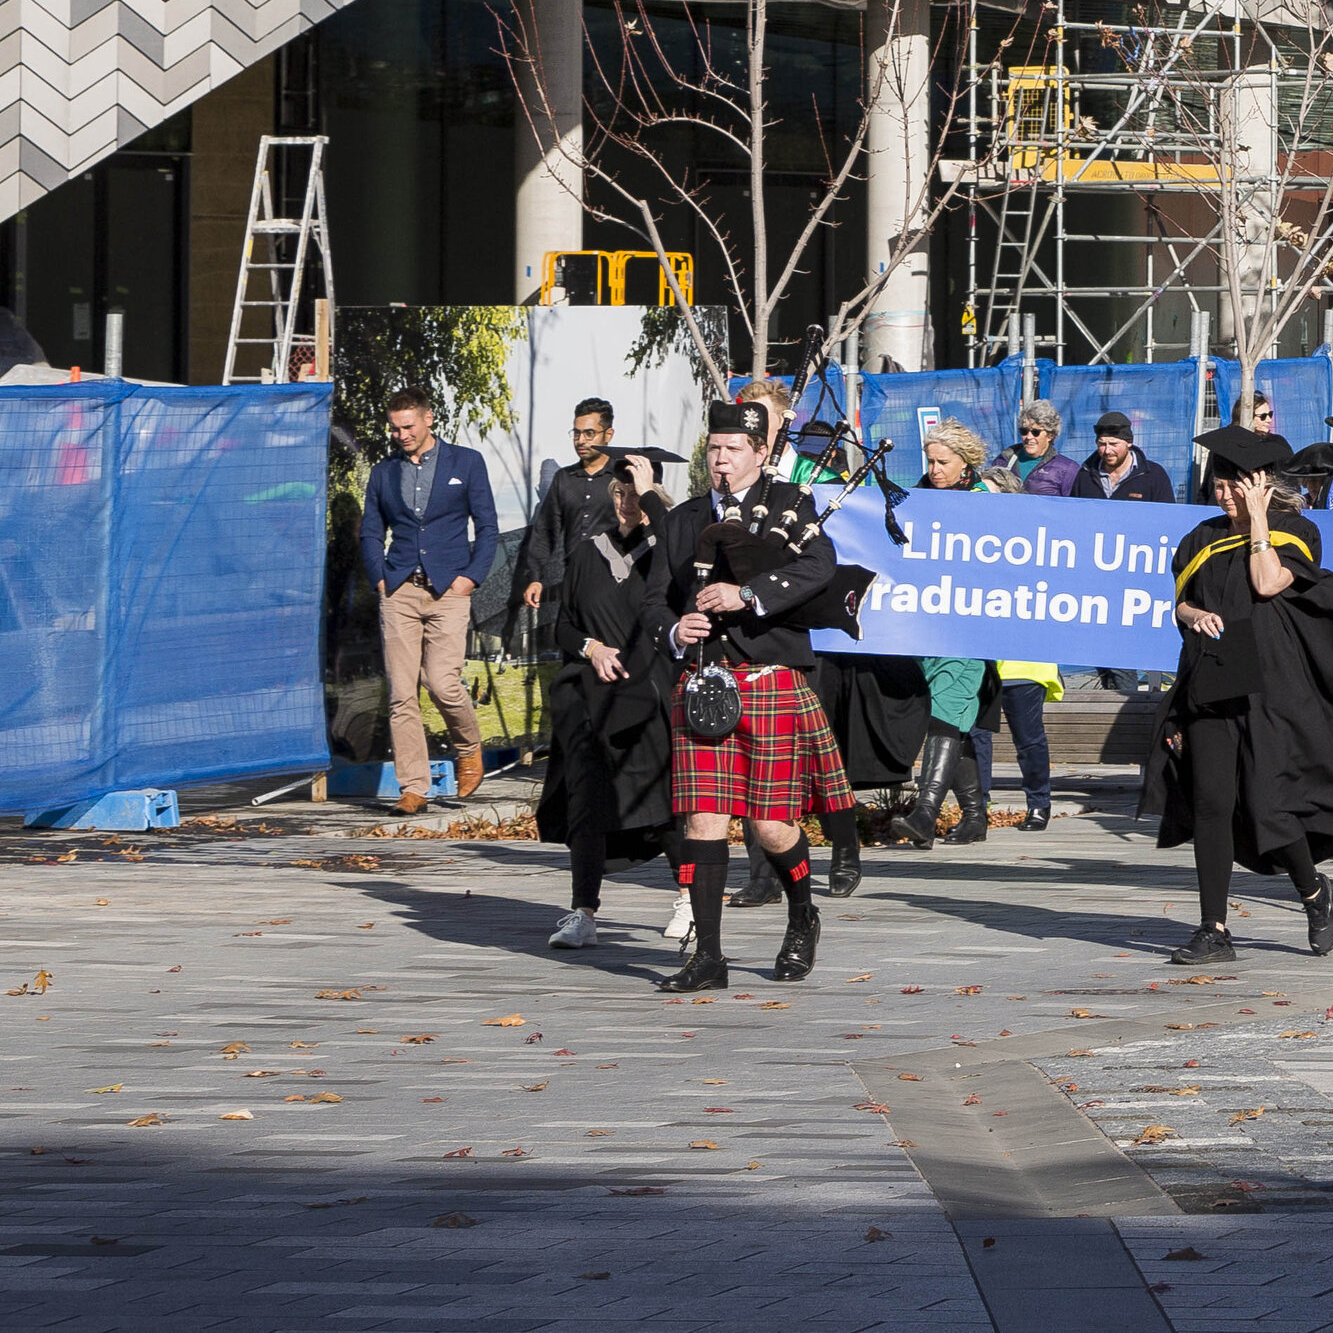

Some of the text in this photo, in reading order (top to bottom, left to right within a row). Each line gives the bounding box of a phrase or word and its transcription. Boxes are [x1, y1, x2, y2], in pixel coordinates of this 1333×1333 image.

[902, 521, 1177, 574] Lincoln Uni
[863, 575, 1177, 628] raduation Pr
